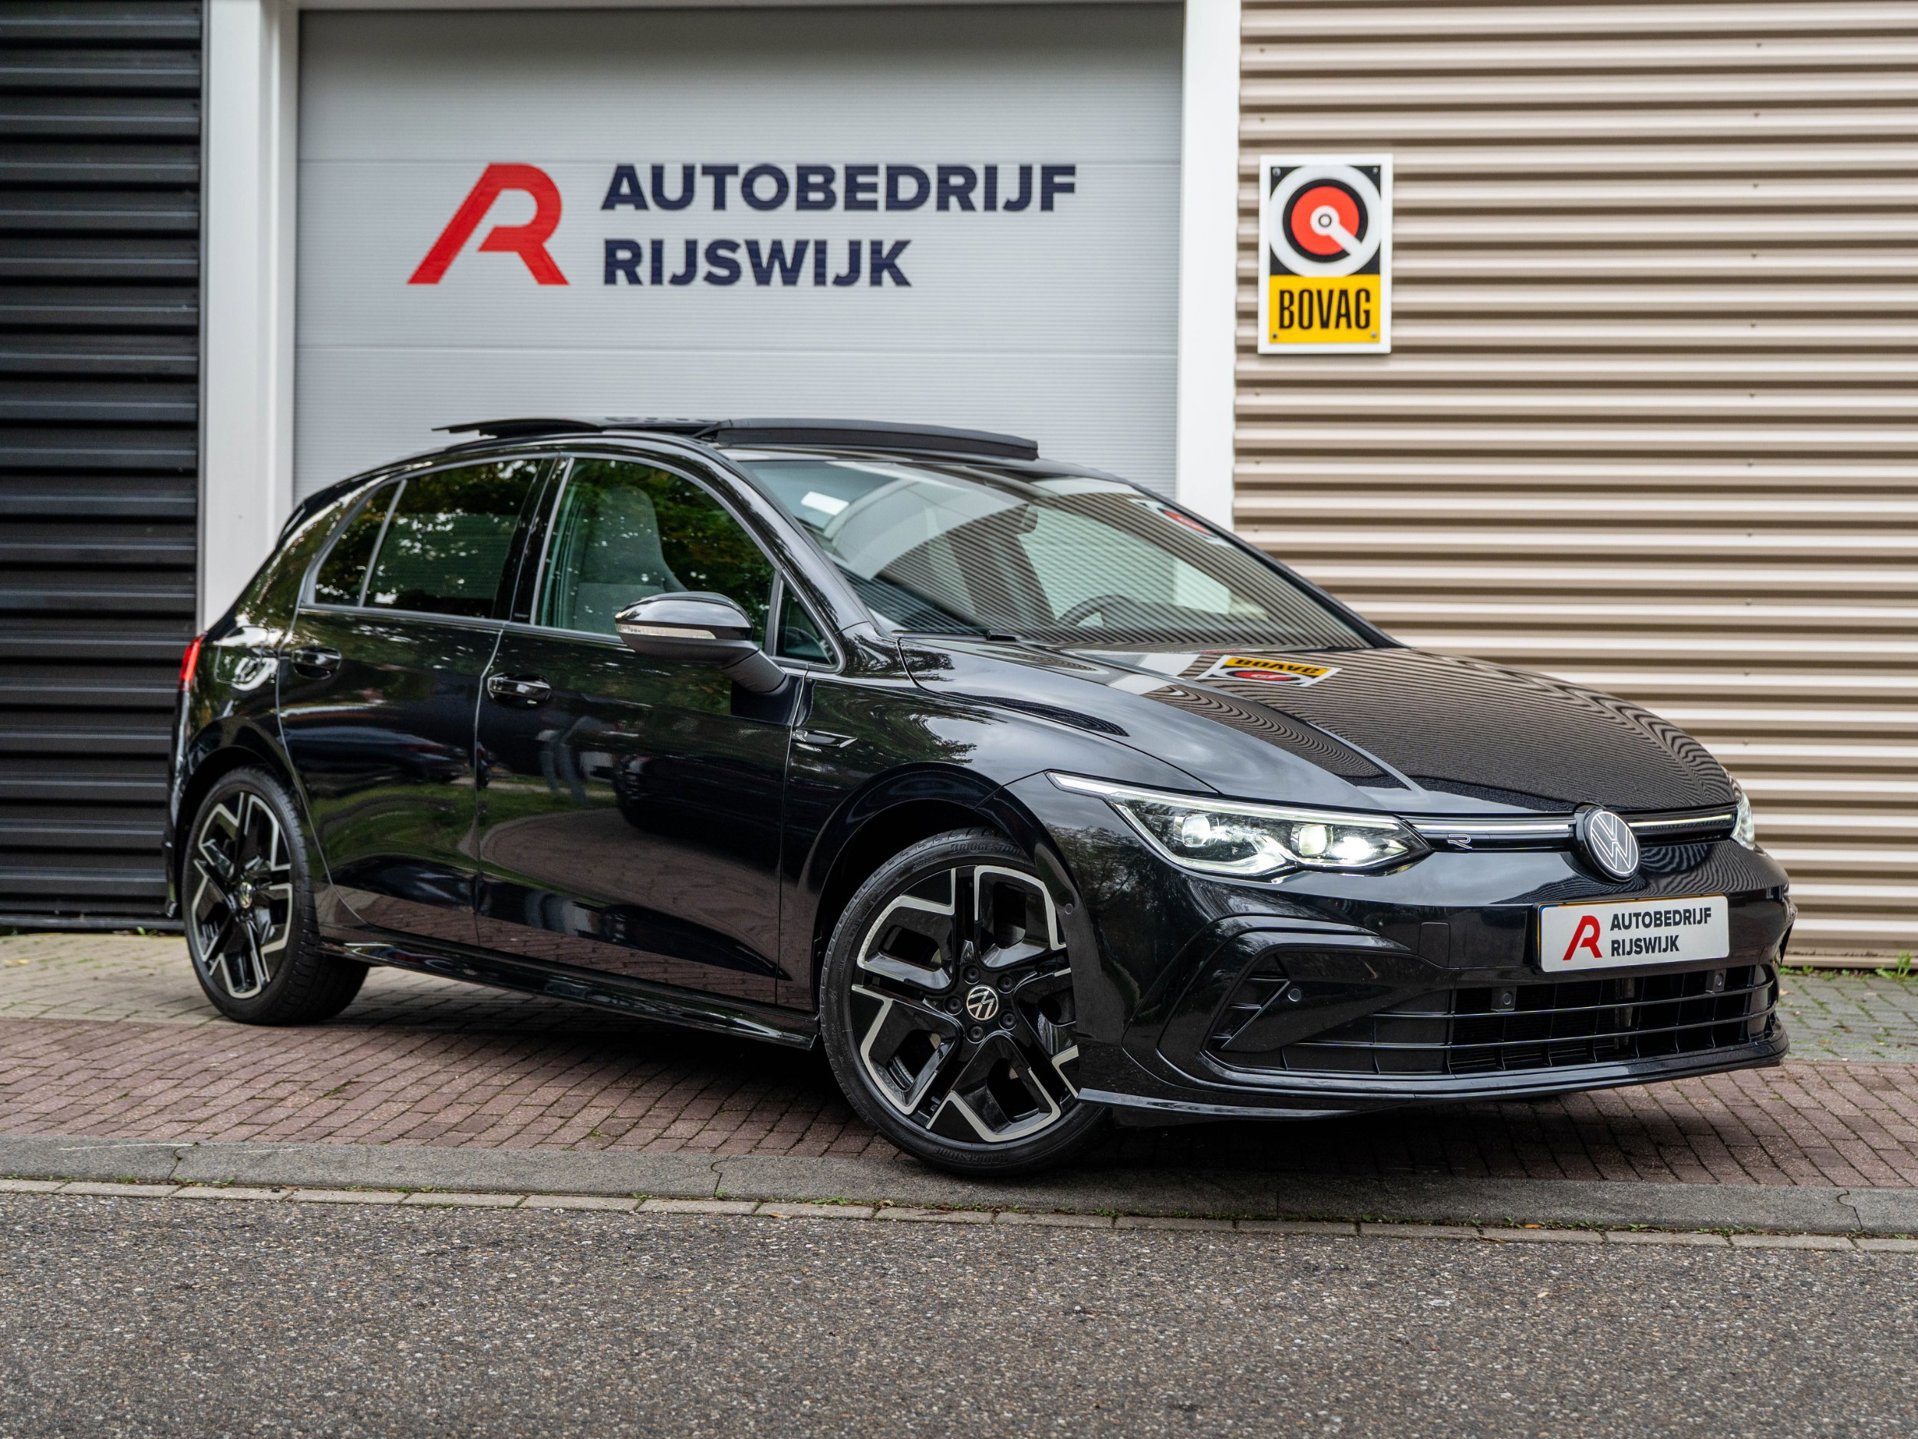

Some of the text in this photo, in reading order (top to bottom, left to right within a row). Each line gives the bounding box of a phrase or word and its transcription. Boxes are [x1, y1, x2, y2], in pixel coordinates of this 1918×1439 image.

[601, 163, 1077, 213] AUTOBEDRIJF
[603, 238, 912, 287] RIJSWIJK
[1278, 287, 1371, 330] BOVAG
[1610, 907, 1712, 931] AUTOBEDRIJF
[1611, 935, 1680, 957] RIJSWIJK
